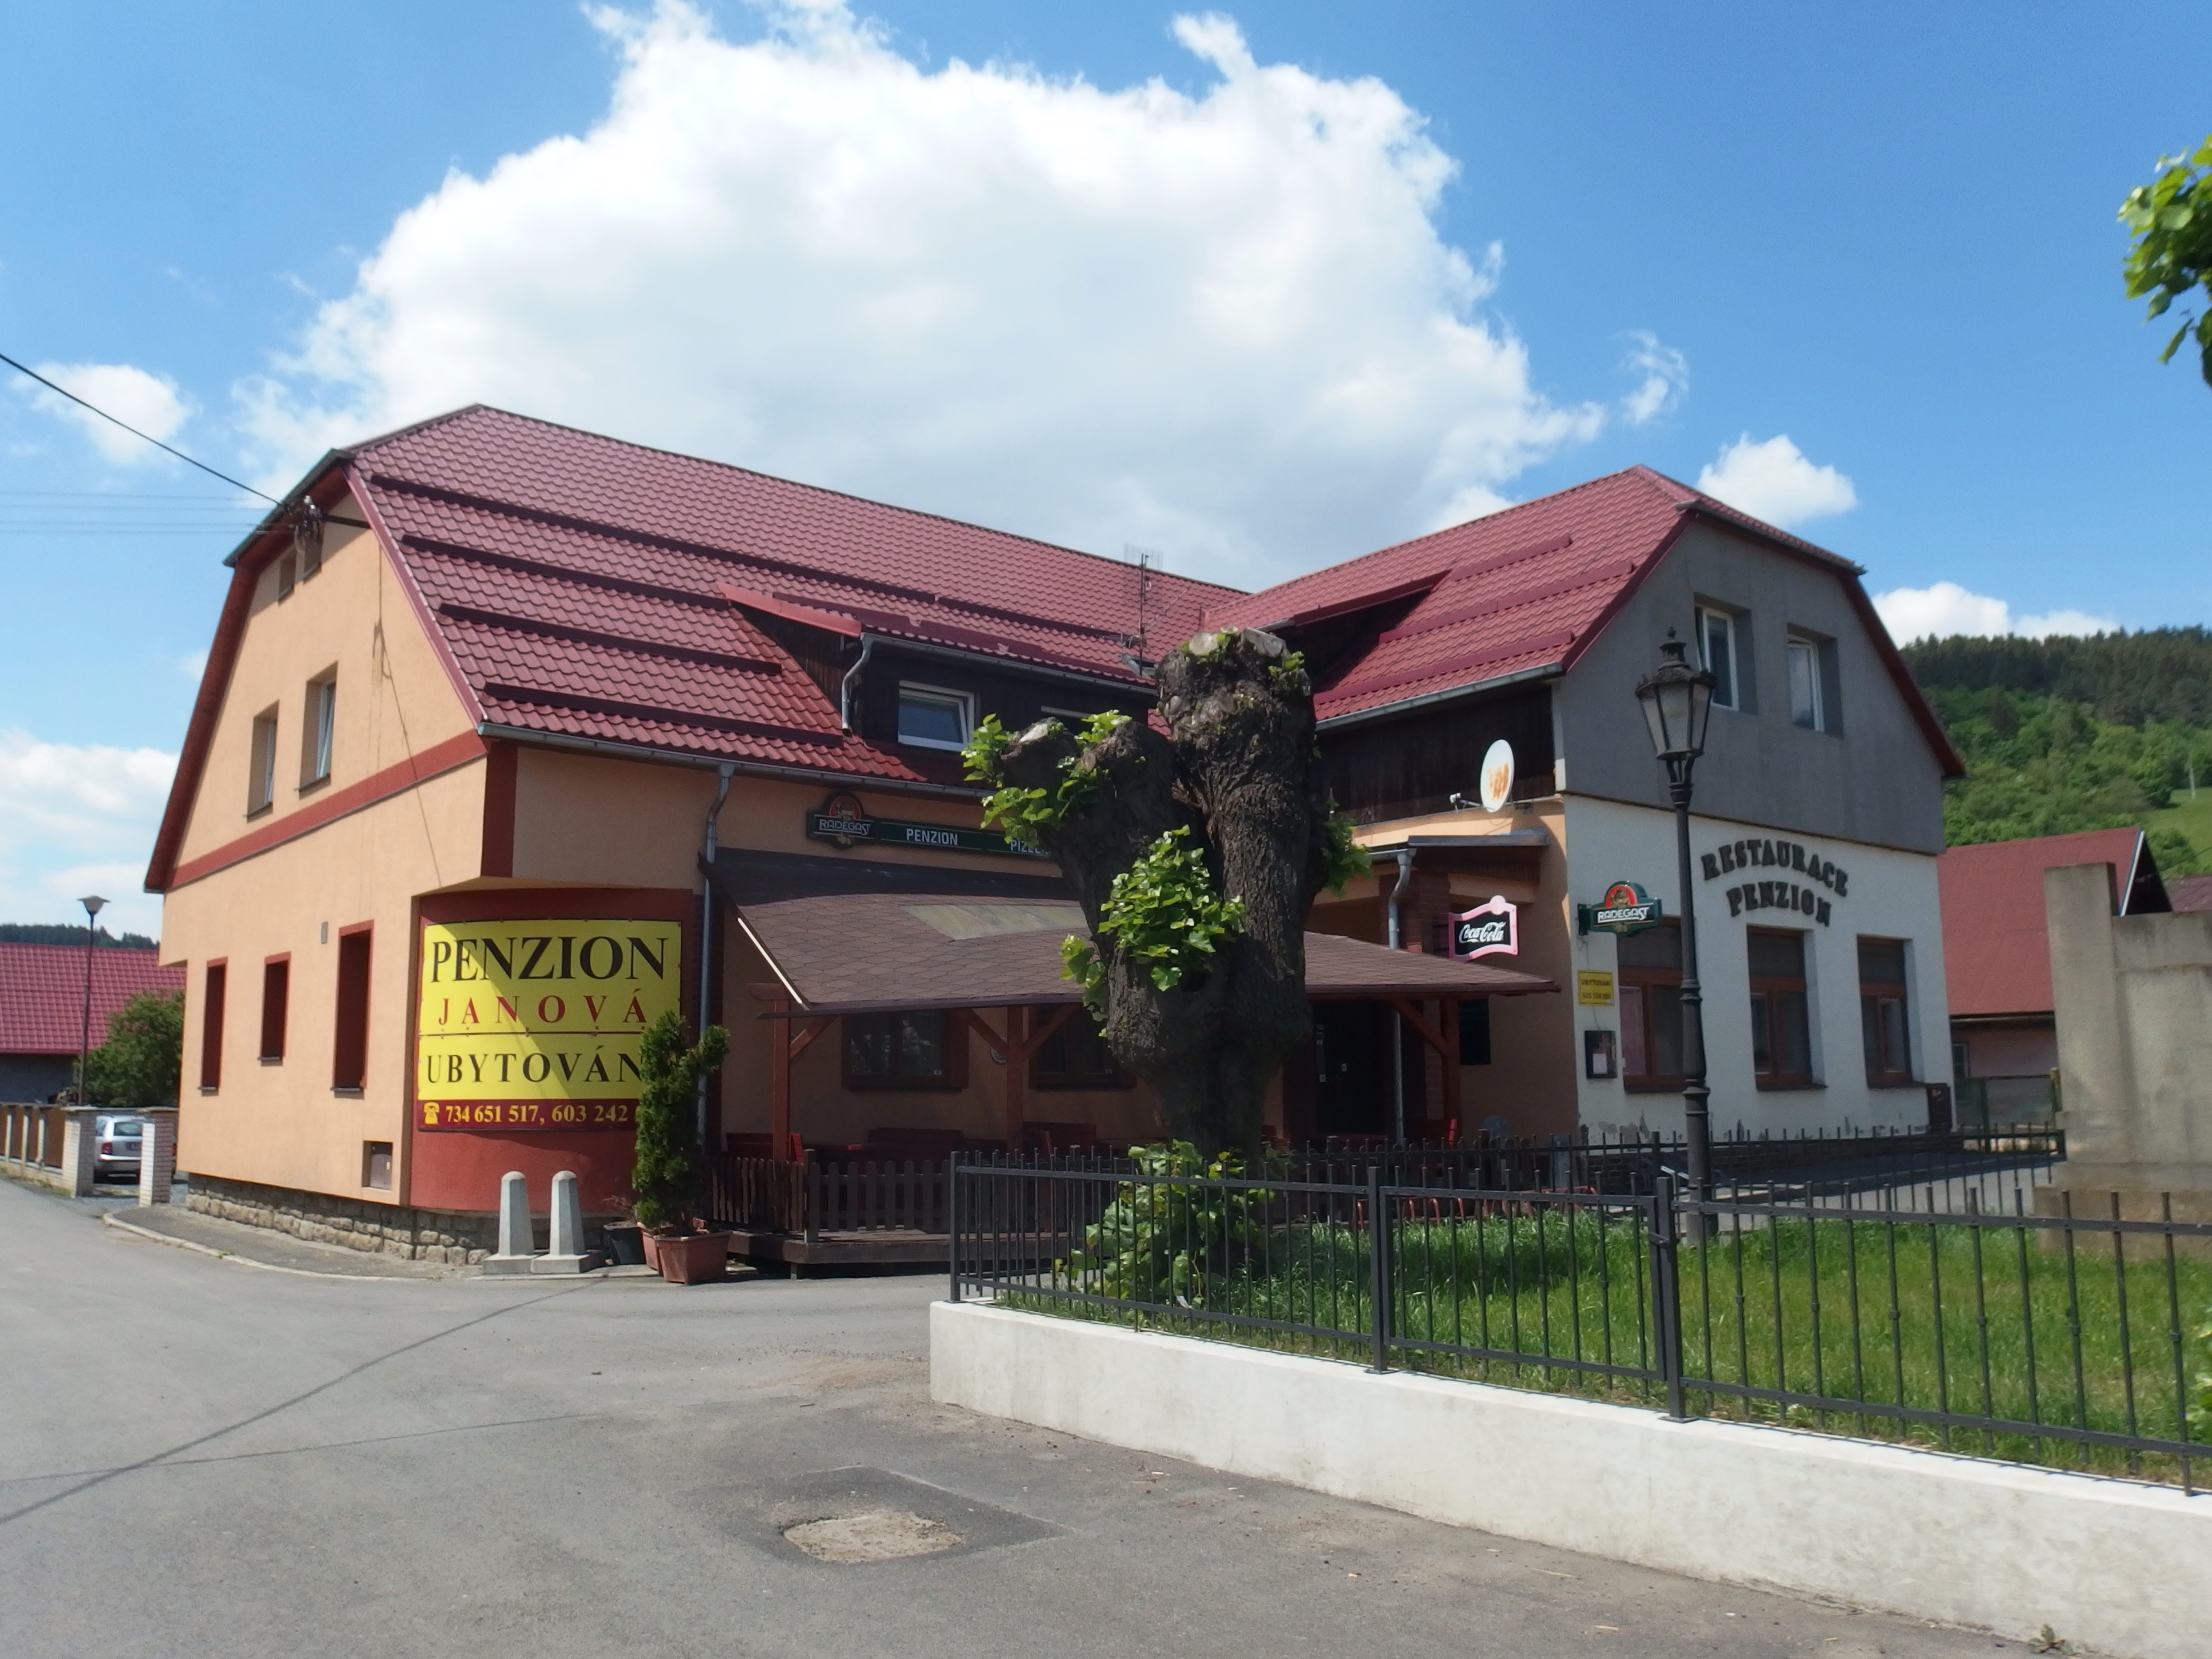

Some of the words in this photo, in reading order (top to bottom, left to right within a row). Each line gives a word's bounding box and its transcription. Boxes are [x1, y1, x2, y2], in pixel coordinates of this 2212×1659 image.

[818, 819, 871, 836] RADEGAST
[906, 828, 958, 846] PENZION
[1701, 838, 1849, 898] RESTAURACE
[1598, 906, 1650, 923] RADEGAST
[1726, 881, 1832, 927] PENZION
[430, 936, 668, 983] PENZION
[438, 988, 647, 1025] JANOVÁ
[427, 1045, 643, 1083] UBYTOVÁN
[445, 1105, 470, 1123] 734
[474, 1105, 502, 1123] 651
[508, 1105, 545, 1124] 517,
[551, 1105, 586, 1122] 603
[594, 1104, 628, 1122] 242
